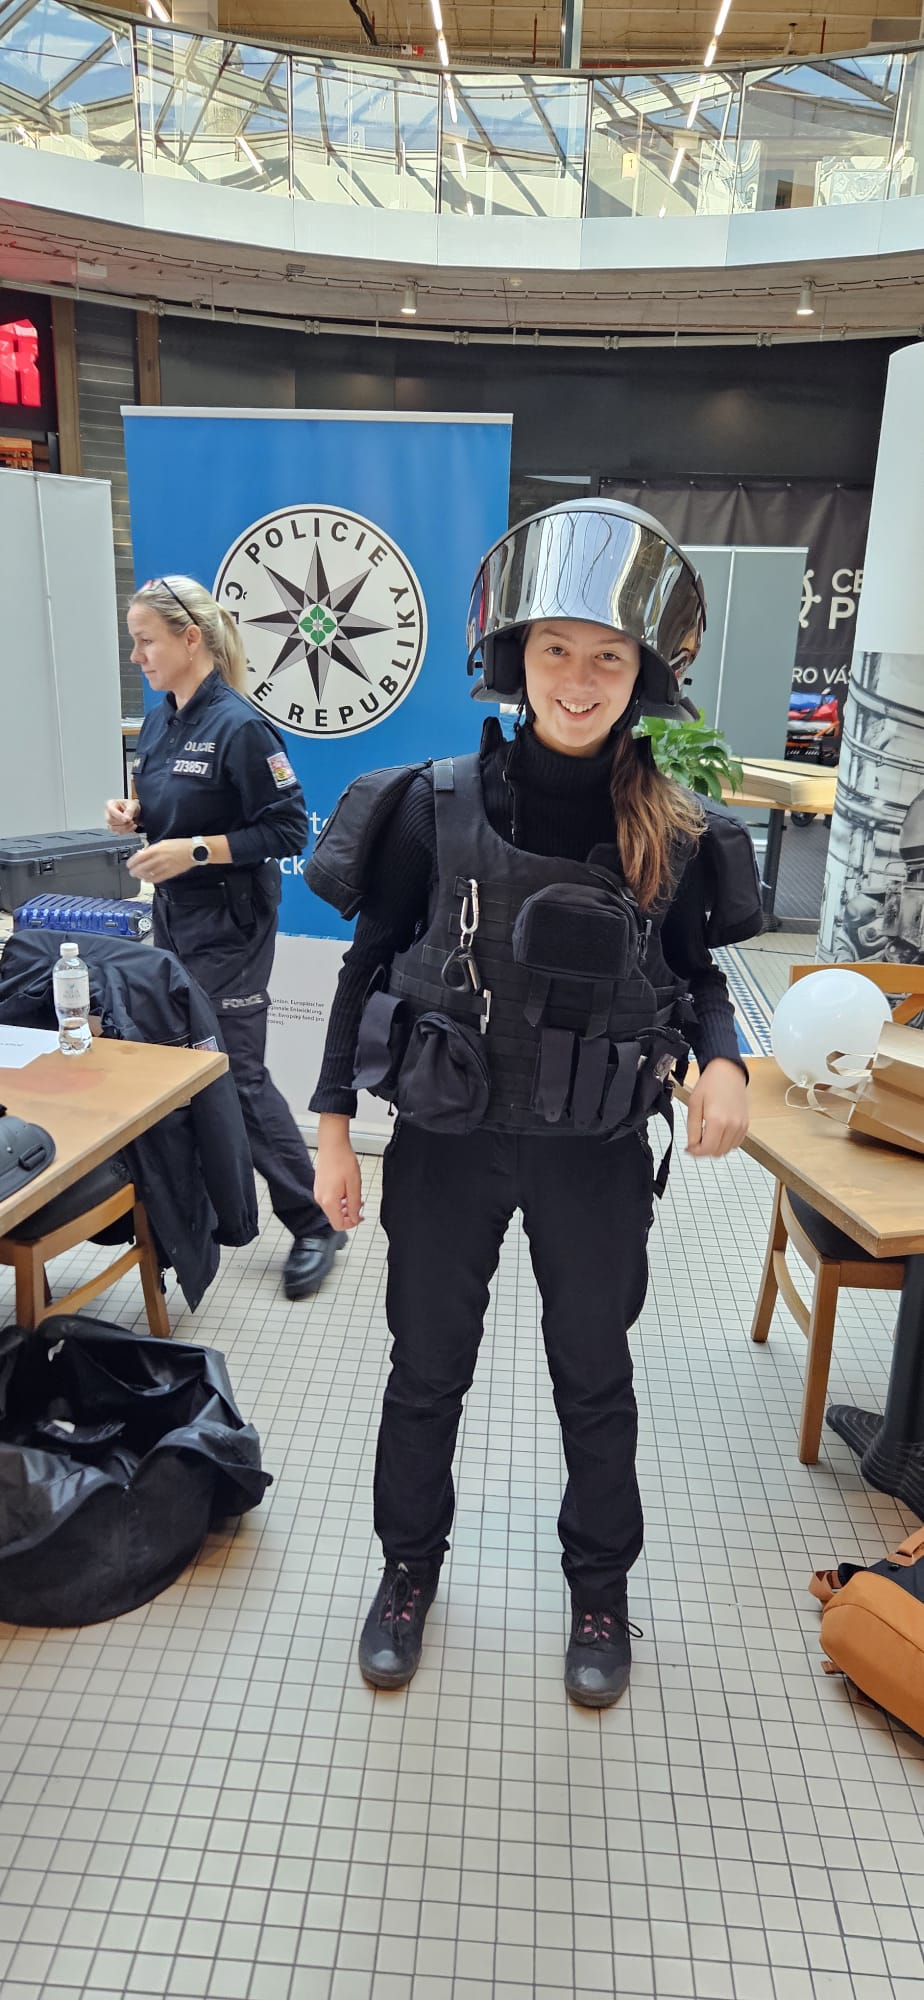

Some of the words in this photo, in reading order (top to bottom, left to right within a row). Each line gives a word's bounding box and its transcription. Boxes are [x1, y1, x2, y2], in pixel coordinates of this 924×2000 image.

[245, 518, 388, 567] POLICIE
[831, 568, 864, 594] CE
[828, 596, 856, 630] P
[288, 586, 416, 727] REPUBLIKY
[791, 667, 818, 684] RO
[823, 664, 851, 685] VÁ
[184, 741, 216, 753] OLICIE
